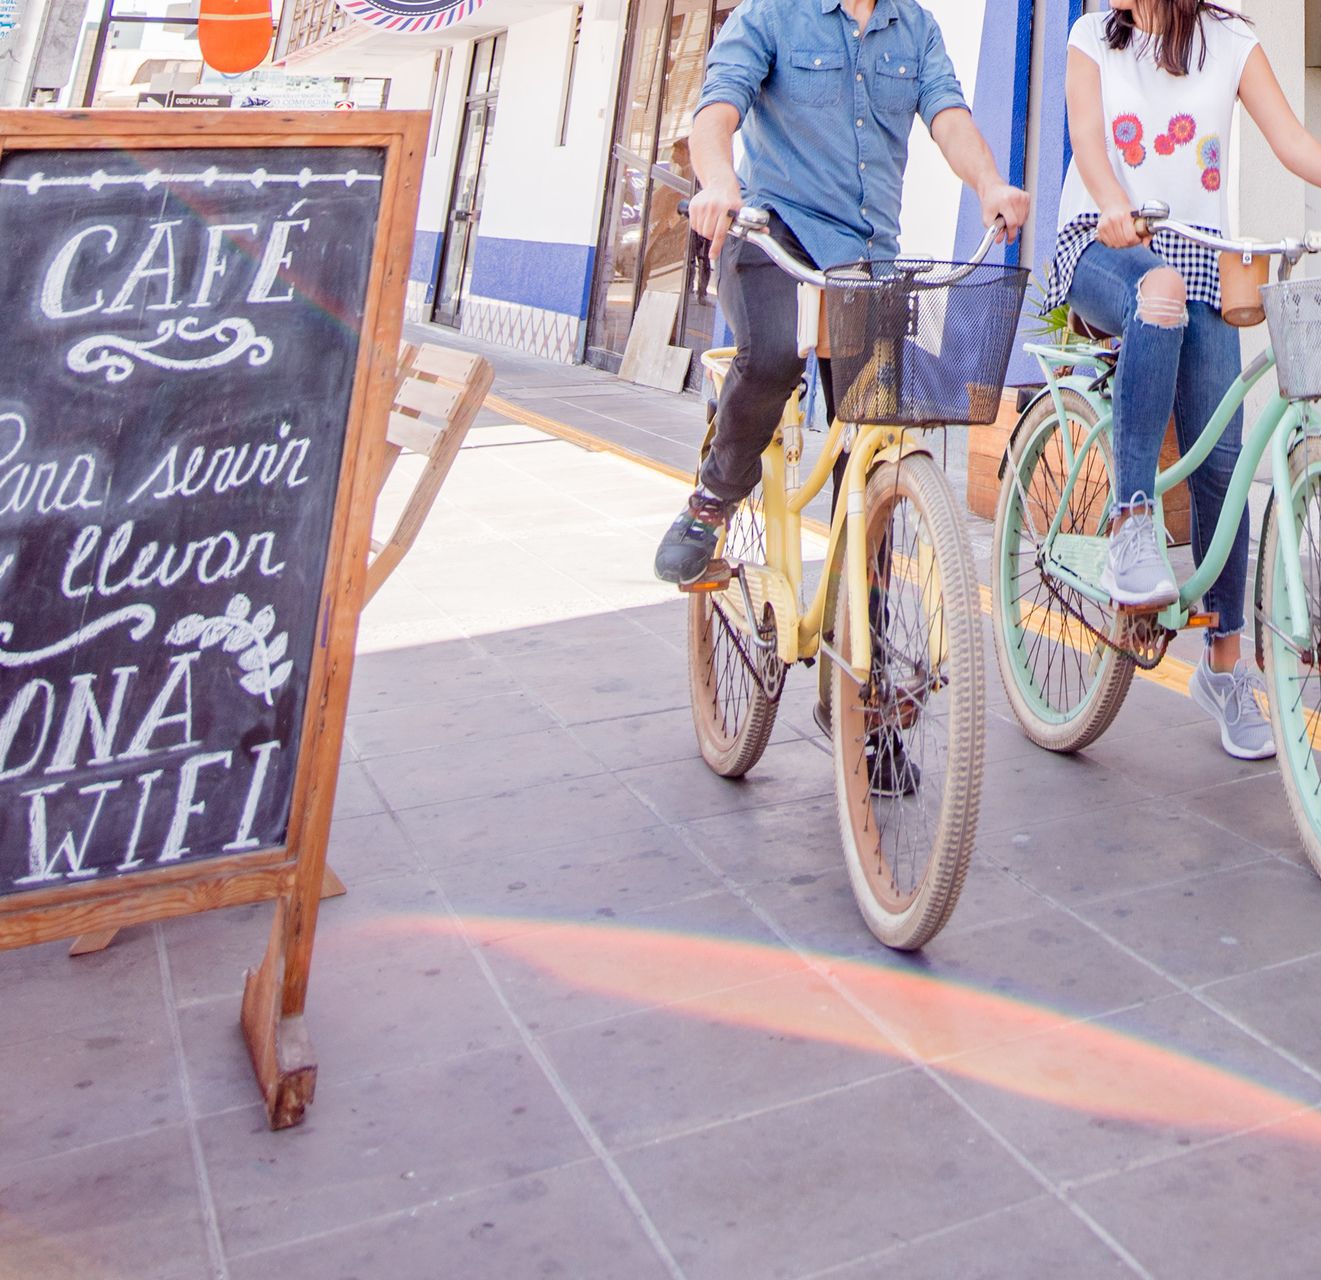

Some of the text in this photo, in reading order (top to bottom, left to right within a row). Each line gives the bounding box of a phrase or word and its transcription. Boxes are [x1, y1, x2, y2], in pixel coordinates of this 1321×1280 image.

[40, 198, 310, 319] CAFÉ
[127, 420, 310, 503] servir
[61, 520, 286, 598] llevar
[13, 741, 281, 884] WIFI
